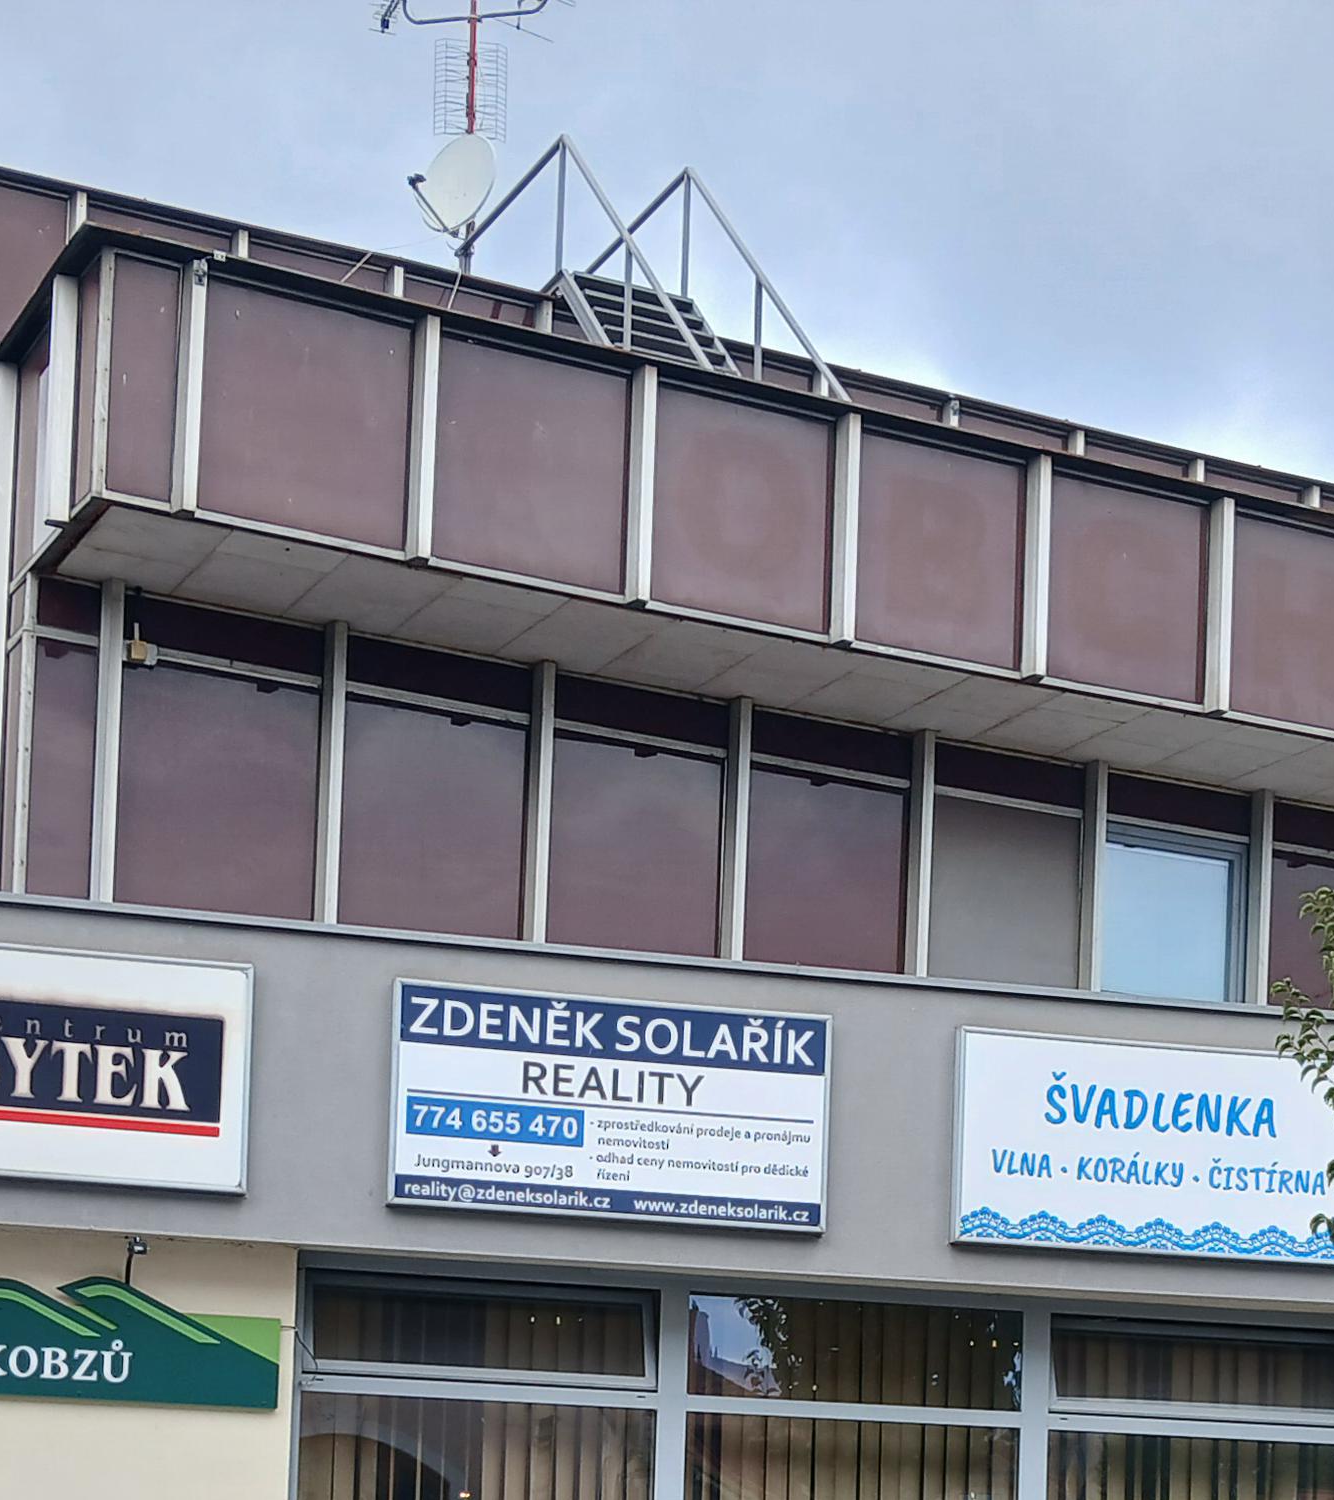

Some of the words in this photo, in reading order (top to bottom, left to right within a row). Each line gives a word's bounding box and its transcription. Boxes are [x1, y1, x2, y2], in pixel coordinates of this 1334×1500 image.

[409, 996, 603, 1051] ZDENĚK
[615, 1015, 815, 1067] SOLAŘÍK
[522, 1060, 705, 1107] REALITY
[412, 1103, 463, 1132] 774
[471, 1108, 521, 1136] 655
[528, 1112, 579, 1140] 470
[1045, 1071, 1277, 1138] ŠVADLENKA
[597, 1118, 694, 1136] zprostředkování
[696, 1125, 741, 1142] prodeje
[744, 1130, 751, 1139] a
[754, 1130, 812, 1146] pronájmu
[598, 1136, 670, 1150] nemovitostí
[414, 1152, 520, 1176] Jungmannova
[524, 1165, 574, 1181] 907/38
[596, 1152, 634, 1166] odhad
[637, 1156, 665, 1170] ceny
[667, 1158, 739, 1173] nemovitostí
[741, 1164, 761, 1176] pro
[763, 1162, 810, 1178] dědické
[991, 1148, 1054, 1179] VLNA
[1077, 1151, 1185, 1189] KORÁLKY
[1209, 1158, 1327, 1196] ČISTÍRNA
[404, 1180, 612, 1209] reality@zdeneksolarik.cz
[633, 1197, 810, 1222] www.zdeneksolarik.cz
